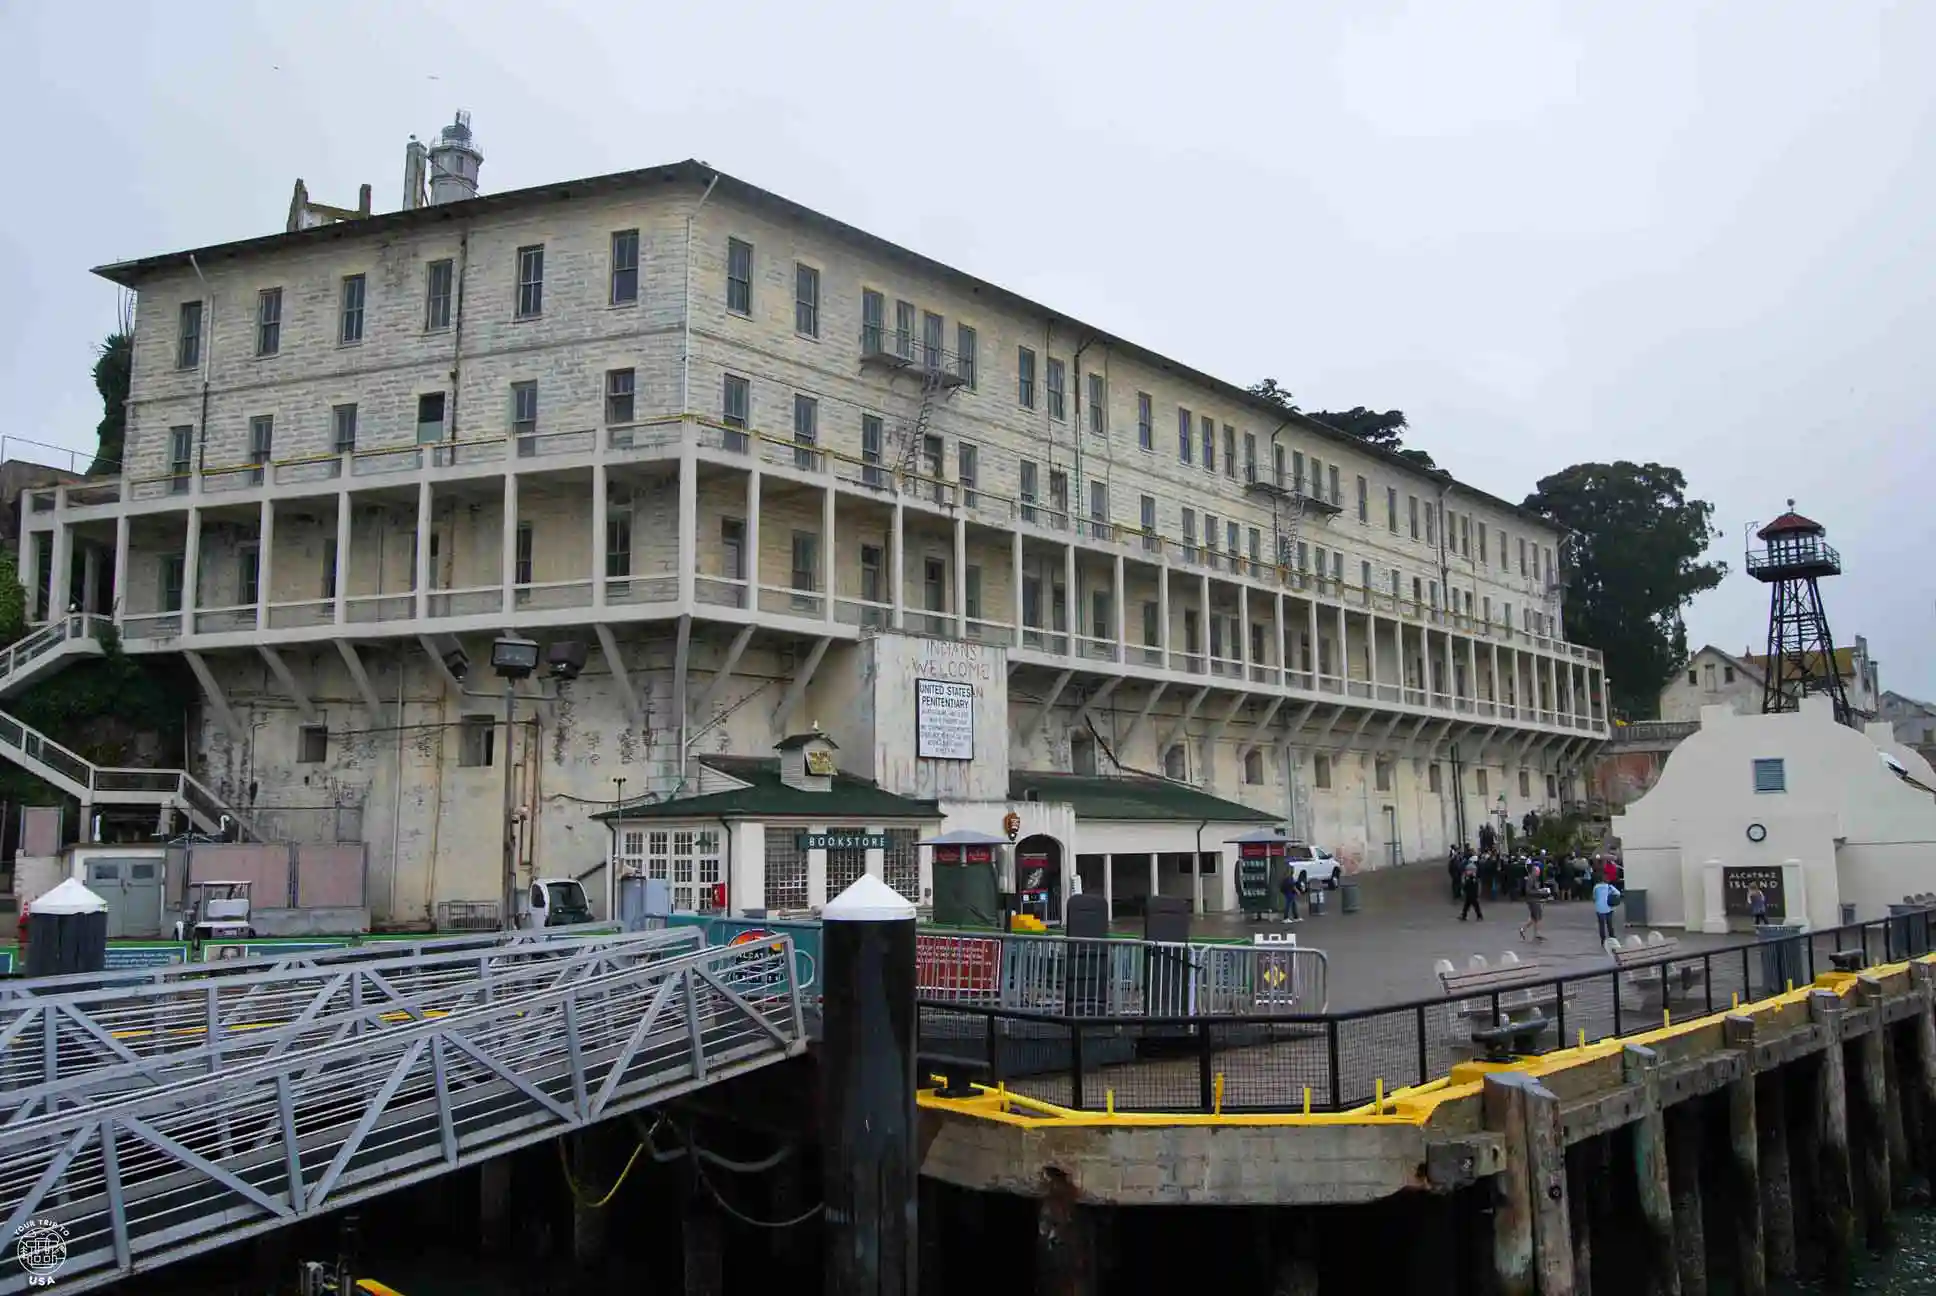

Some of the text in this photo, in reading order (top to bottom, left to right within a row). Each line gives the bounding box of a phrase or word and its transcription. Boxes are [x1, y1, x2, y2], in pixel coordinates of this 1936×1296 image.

[911, 658, 990, 680] WELCOME
[919, 684, 944, 696] UNITED
[945, 685, 971, 698] STATES
[921, 697, 969, 709] PENITENTIARY
[809, 836, 885, 848] BOOKSTORE
[1729, 881, 1778, 889] ISLND
